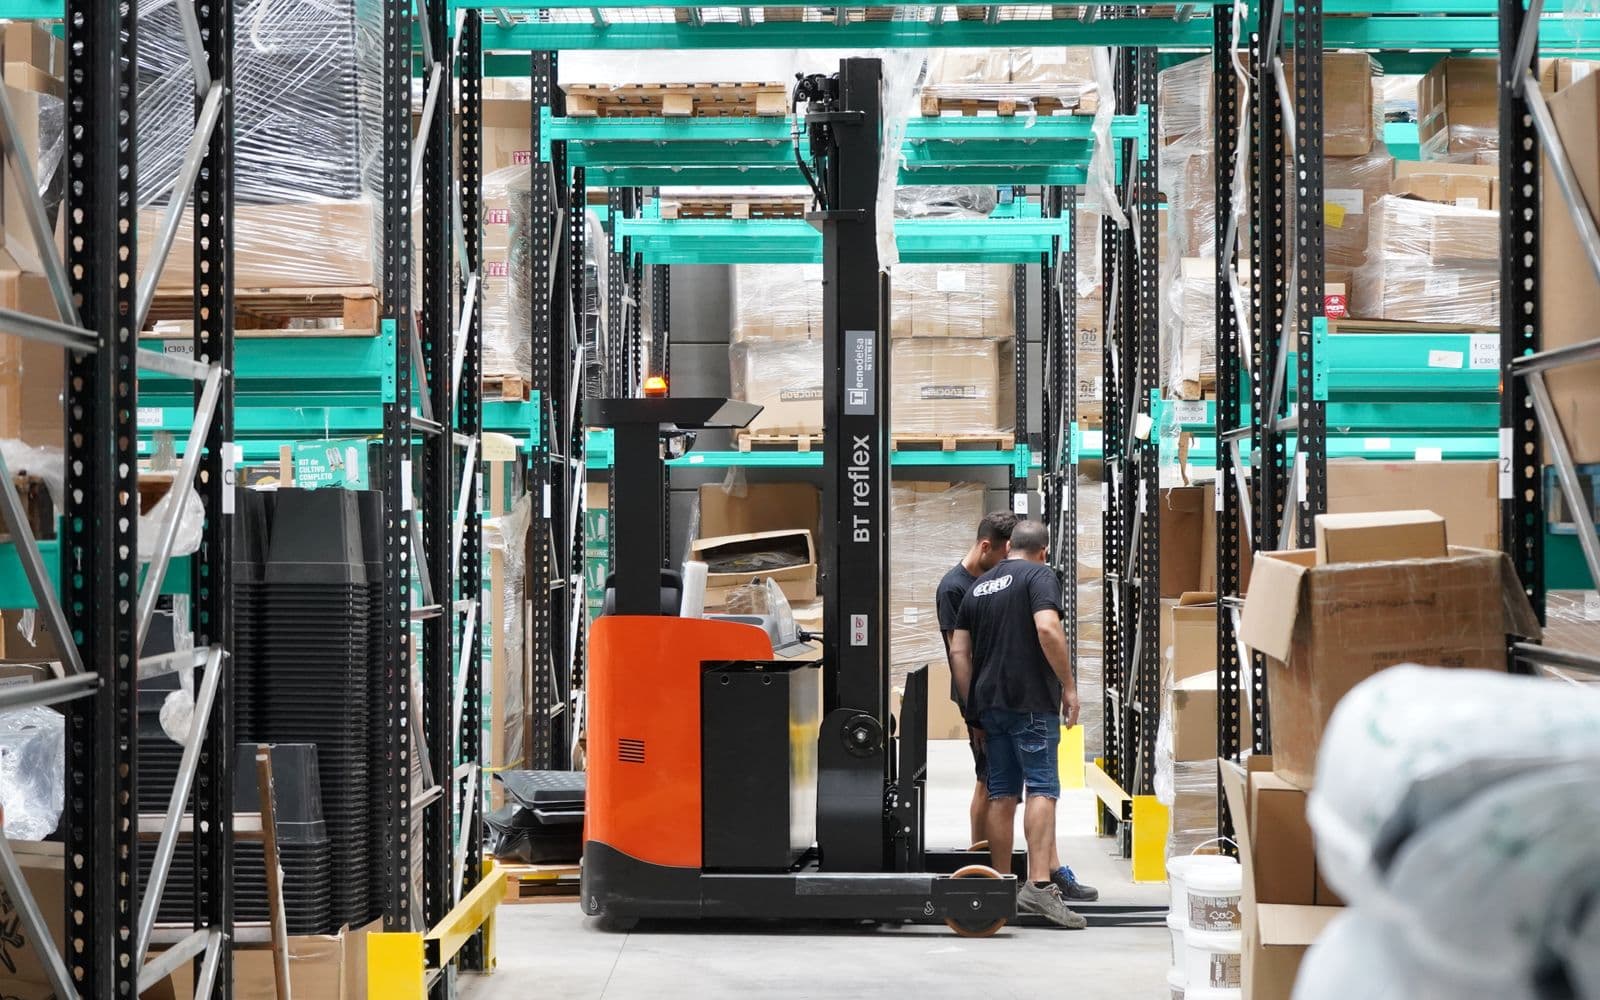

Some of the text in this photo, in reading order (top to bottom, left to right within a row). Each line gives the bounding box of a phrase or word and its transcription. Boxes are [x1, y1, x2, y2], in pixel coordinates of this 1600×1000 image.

[847, 434, 870, 542] BT reflex
[1500, 457, 1511, 473] 2
